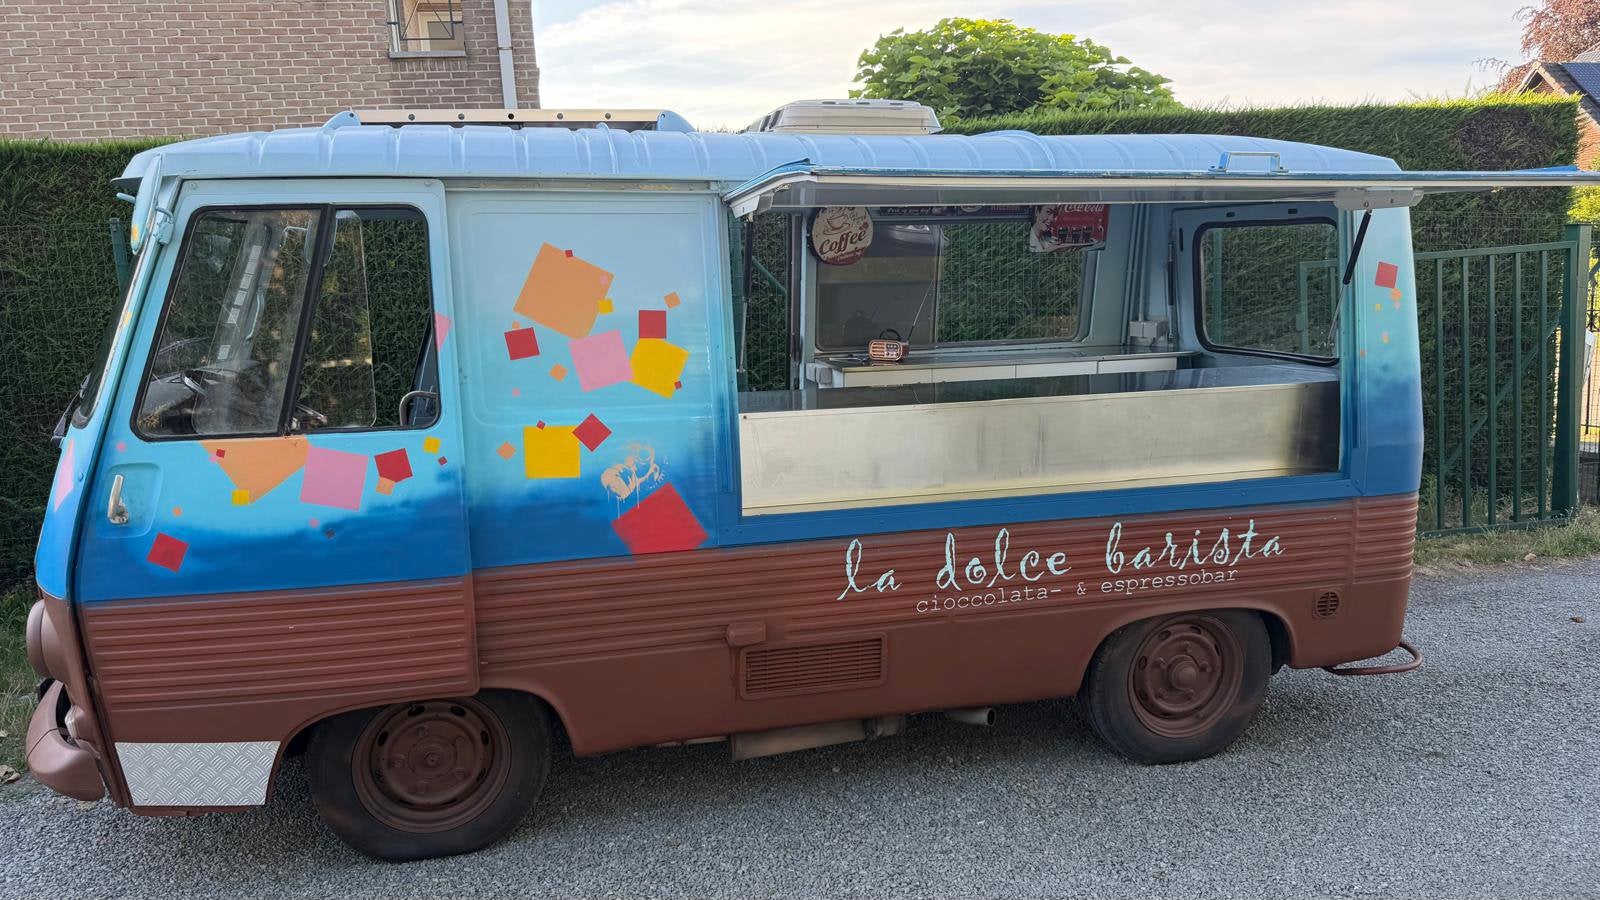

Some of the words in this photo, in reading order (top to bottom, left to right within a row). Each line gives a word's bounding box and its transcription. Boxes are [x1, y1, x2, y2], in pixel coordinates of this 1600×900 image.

[819, 231, 866, 255] Coffee
[837, 538, 902, 601] la
[935, 527, 1071, 591] dolce
[1105, 519, 1286, 574] barista
[915, 586, 1062, 614] cioccolata-
[1076, 581, 1088, 597] &
[1100, 568, 1239, 596] espressobar
